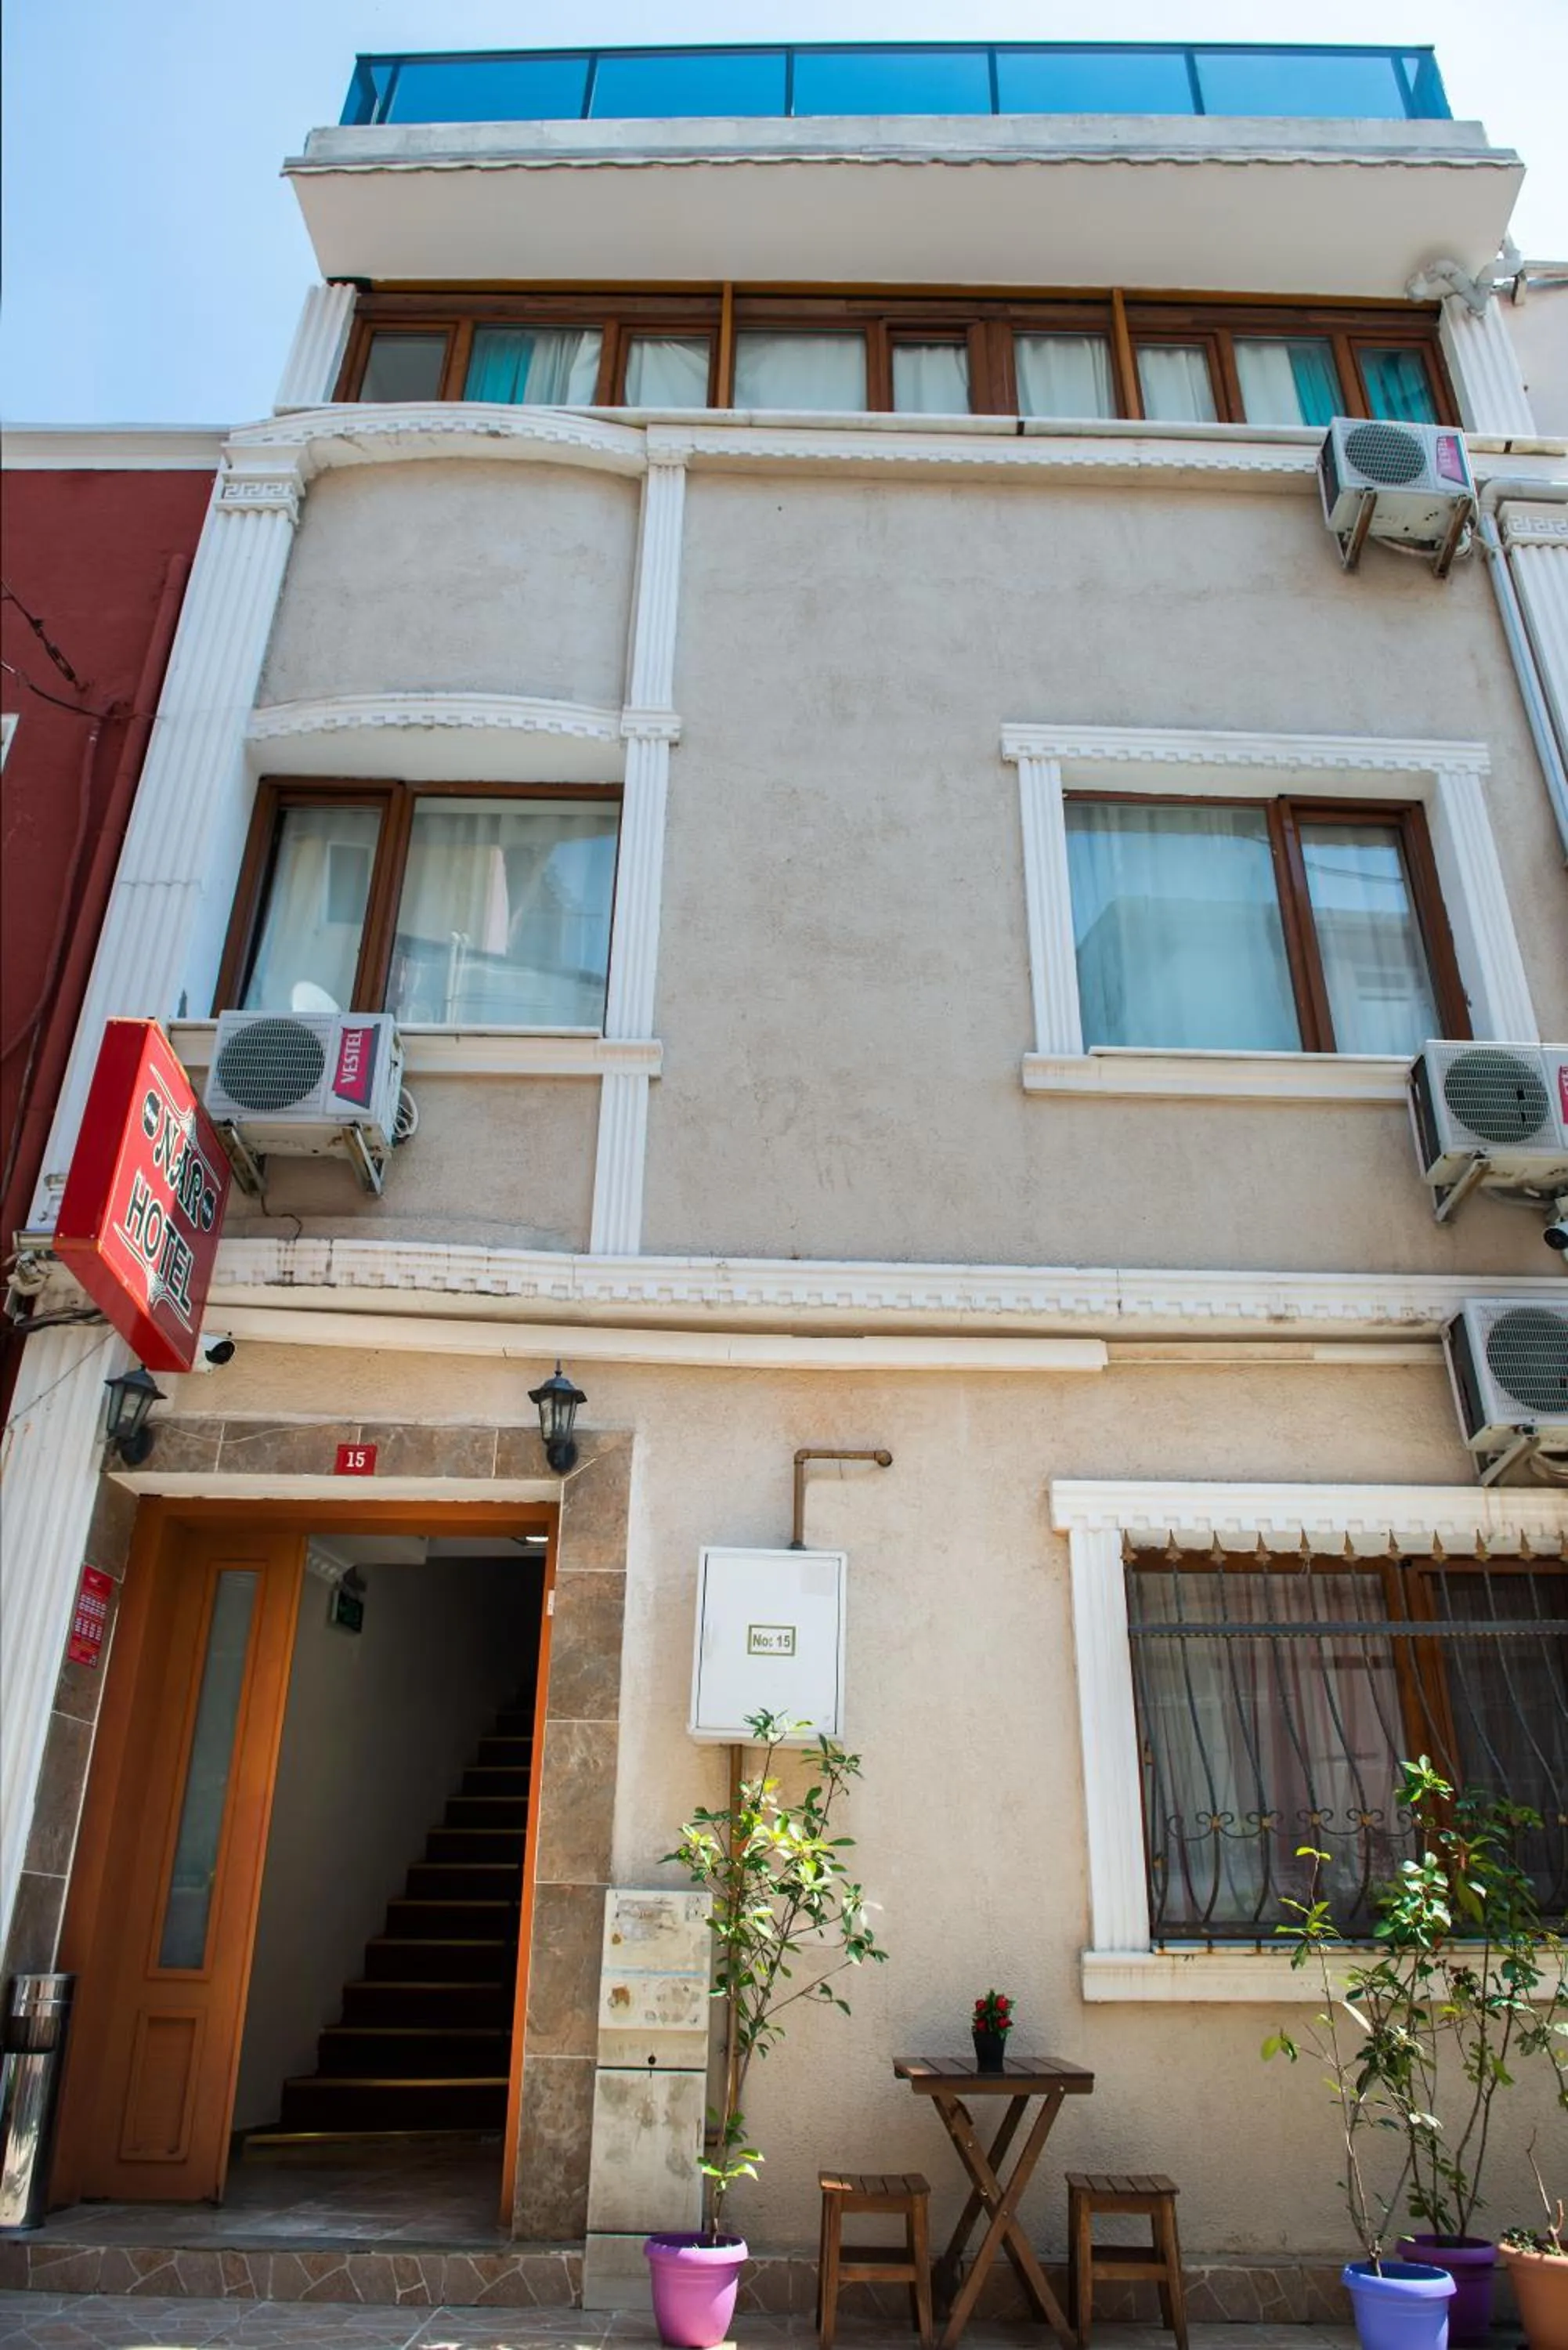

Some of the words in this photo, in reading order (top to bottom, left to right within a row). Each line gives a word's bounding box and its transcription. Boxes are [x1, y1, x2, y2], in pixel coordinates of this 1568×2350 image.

[341, 1030, 363, 1083] VESTEL
[154, 1105, 204, 1227] NAR
[125, 1169, 194, 1316] HOTEL
[346, 1452, 366, 1467] 15
[753, 1633, 773, 1647] No:
[777, 1635, 790, 1648] 15
